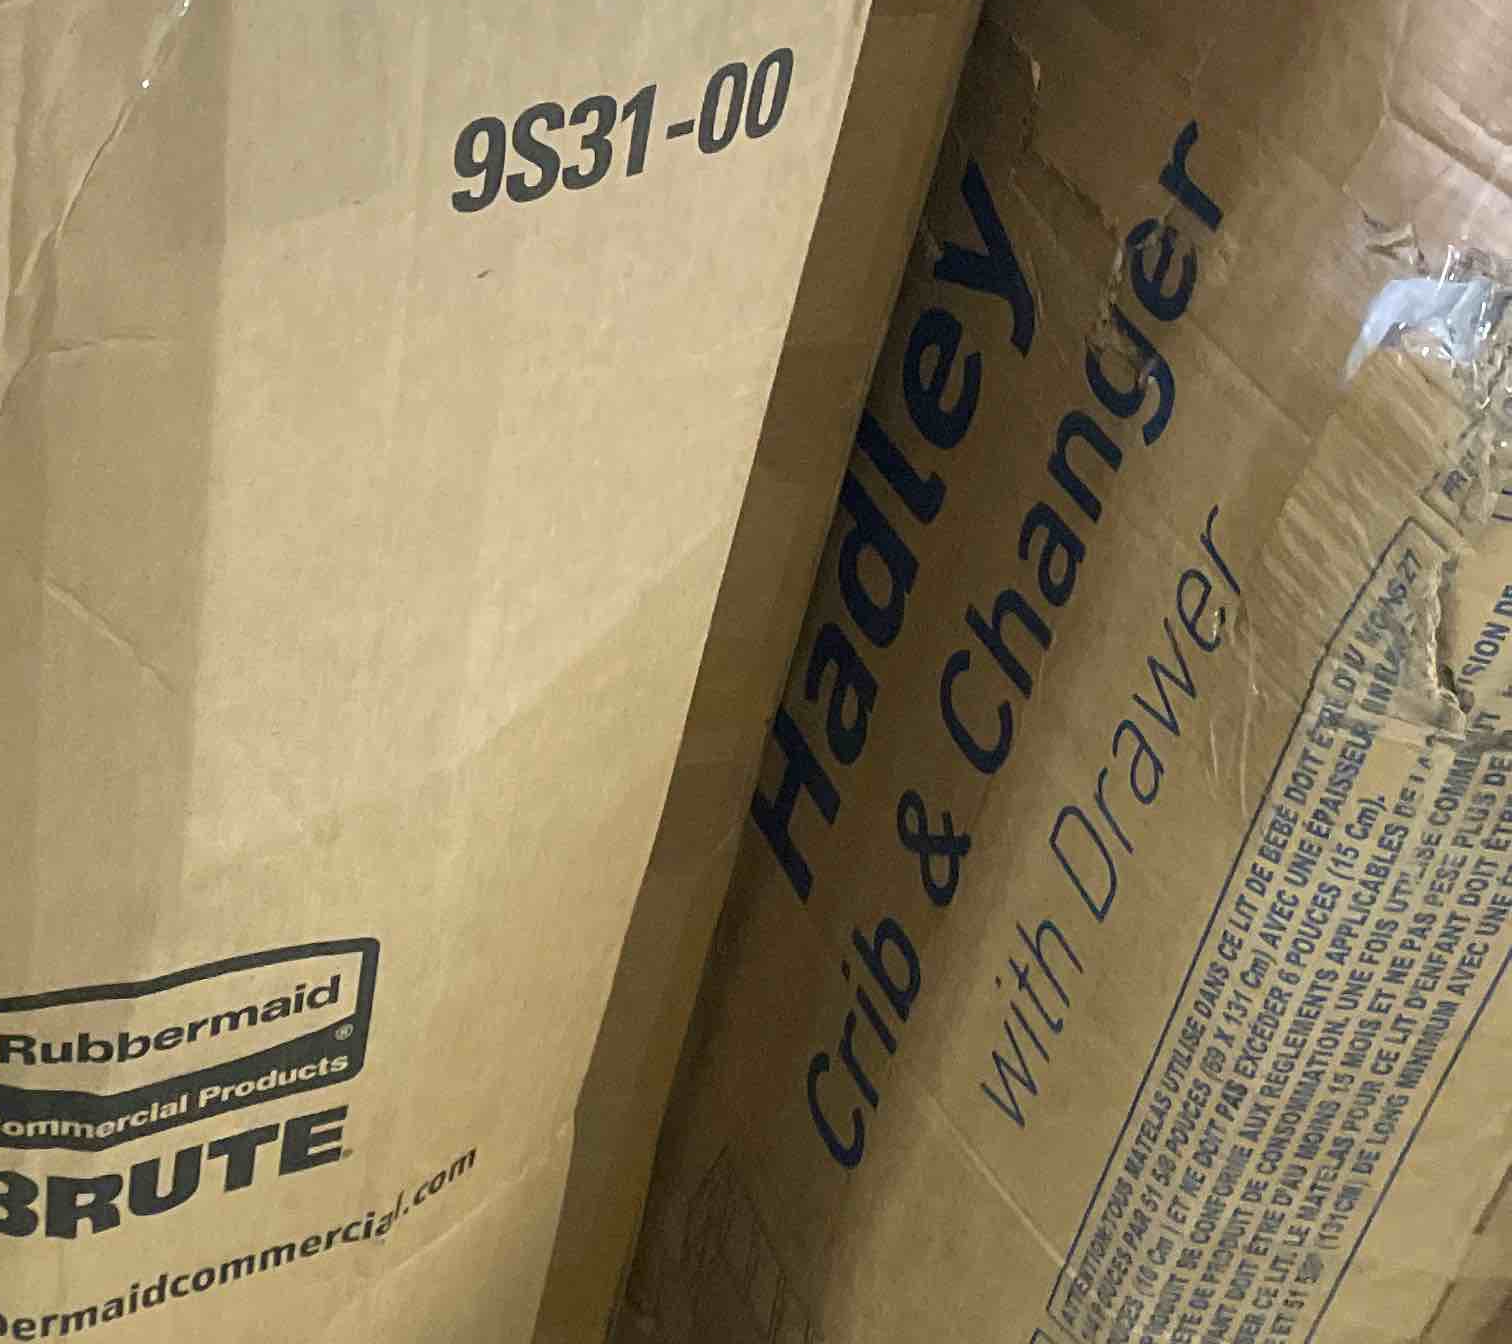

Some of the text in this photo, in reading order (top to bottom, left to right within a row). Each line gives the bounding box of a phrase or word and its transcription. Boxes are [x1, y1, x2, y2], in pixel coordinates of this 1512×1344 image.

[451, 47, 794, 213] 9S31-00
[752, 162, 1035, 900] Hadley
[805, 120, 1223, 1171] Crib & Changer
[1283, 747, 1324, 805] DOIT
[981, 504, 1246, 1129] with Drawer
[1244, 862, 1274, 897] DE
[1283, 839, 1323, 887] UNE
[1285, 881, 1342, 968] POUCES
[1325, 841, 1360, 881] (15
[1344, 795, 1387, 841] Cm).
[1456, 855, 1499, 907] DOIT
[1227, 893, 1259, 932] LIT
[1258, 889, 1300, 950] AVEC
[1399, 912, 1438, 953] PAS
[1217, 929, 1244, 962] CE
[1239, 948, 1278, 990] Cm)
[1381, 955, 1415, 985] NE
[1403, 911, 1470, 1010] D'ENFANT
[1445, 942, 1490, 997] AVEC
[1193, 961, 1230, 1019] DANS
[1222, 989, 1253, 1026] 131
[1238, 1101, 1272, 1143] AUX
[1325, 823, 1409, 965] APPLICABLES
[1366, 987, 1397, 1015] ET
[1340, 1018, 1382, 1069] MOIS
[1383, 1013, 1418, 1045] LIT
[198, 1050, 350, 1110] Products
[1239, 1178, 1269, 1204] DE
[1334, 969, 1374, 1011] UNE
[1357, 918, 1400, 966] FOIS
[1327, 1072, 1356, 1094] 15
[1370, 1048, 1401, 1076] CE
[1164, 1078, 1212, 1156] POUCES
[1341, 1080, 1385, 1133] POUR
[1123, 1091, 1172, 1179] MATELAS
